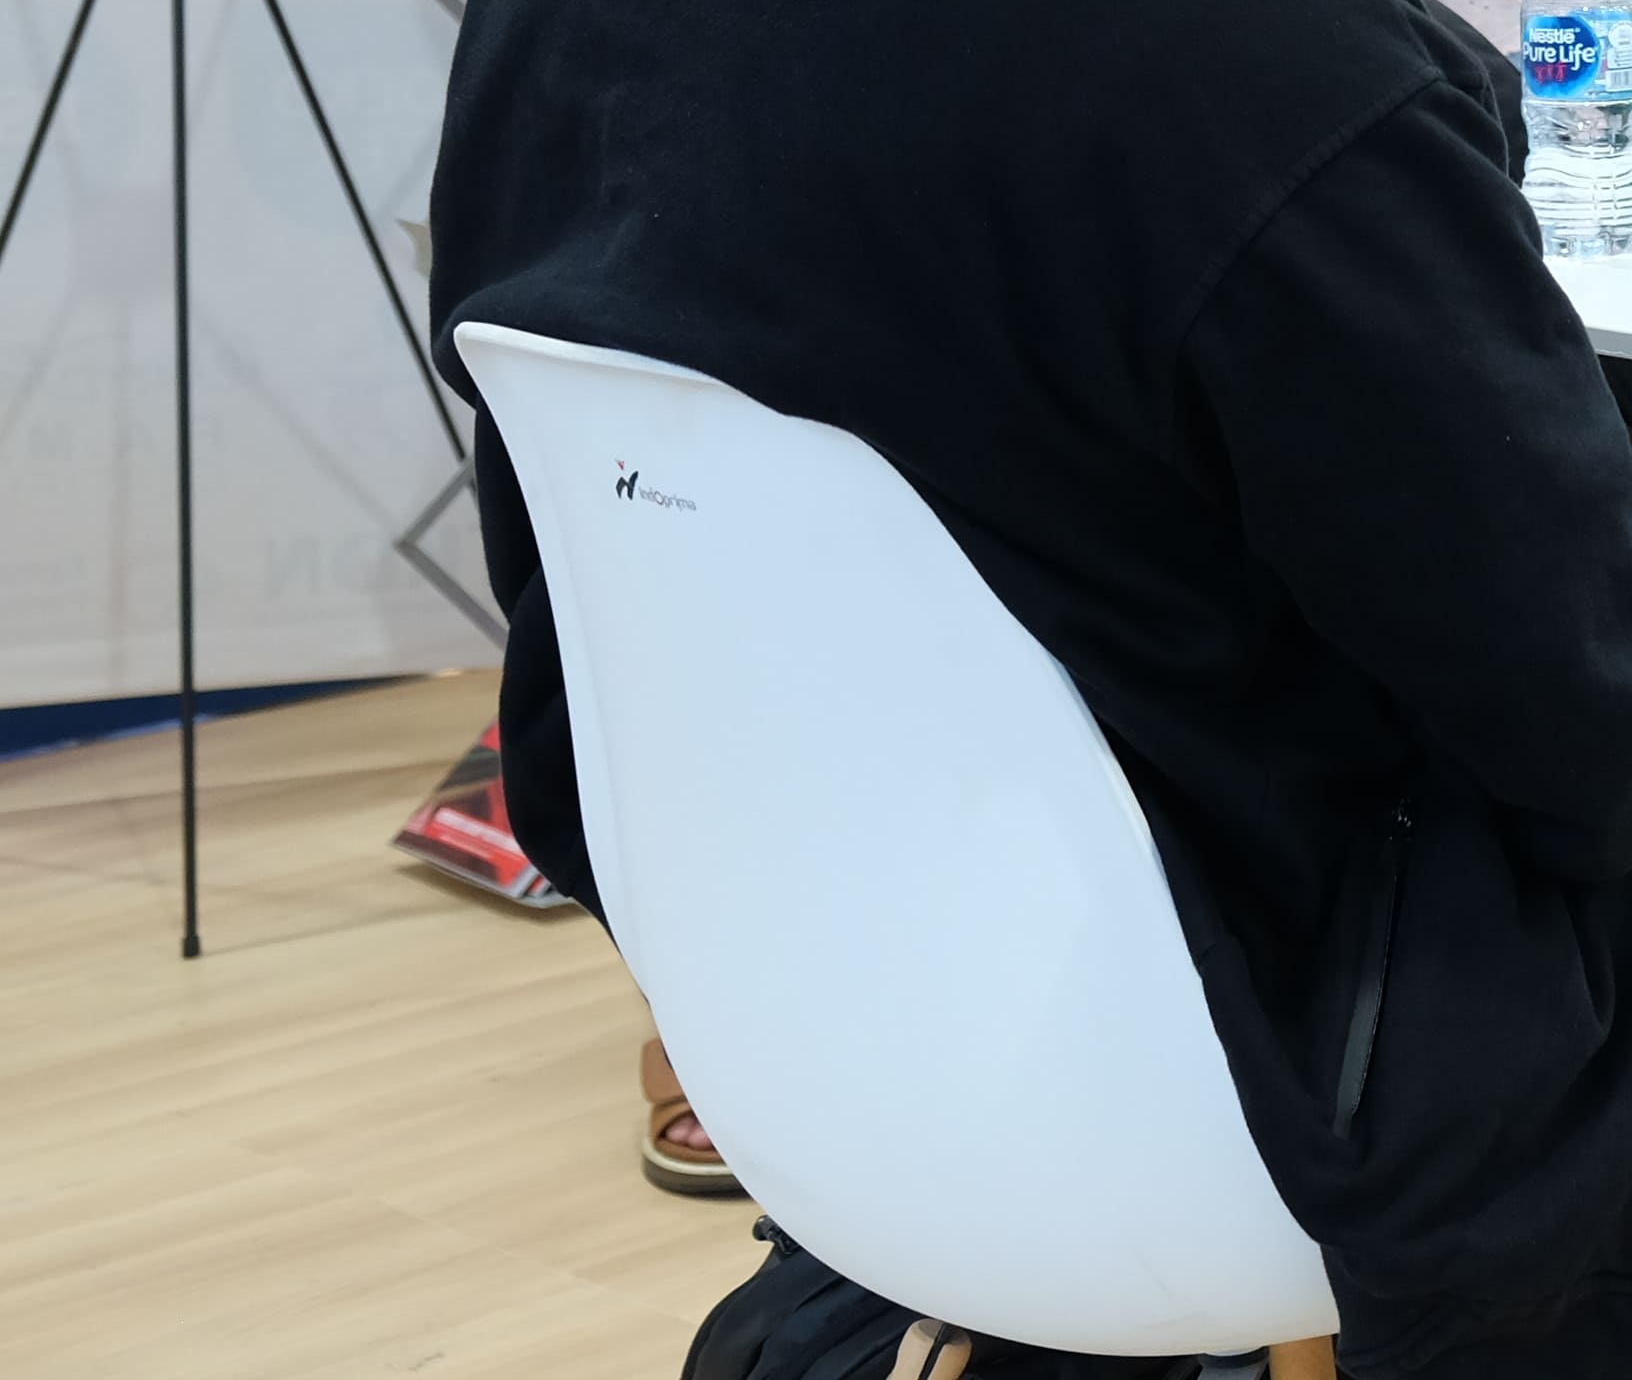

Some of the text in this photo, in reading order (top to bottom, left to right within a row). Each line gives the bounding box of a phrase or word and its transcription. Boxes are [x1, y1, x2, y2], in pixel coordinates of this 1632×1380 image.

[1528, 27, 1576, 45] Nestlé
[1523, 43, 1557, 64] Pure
[1558, 42, 1597, 71] Life
